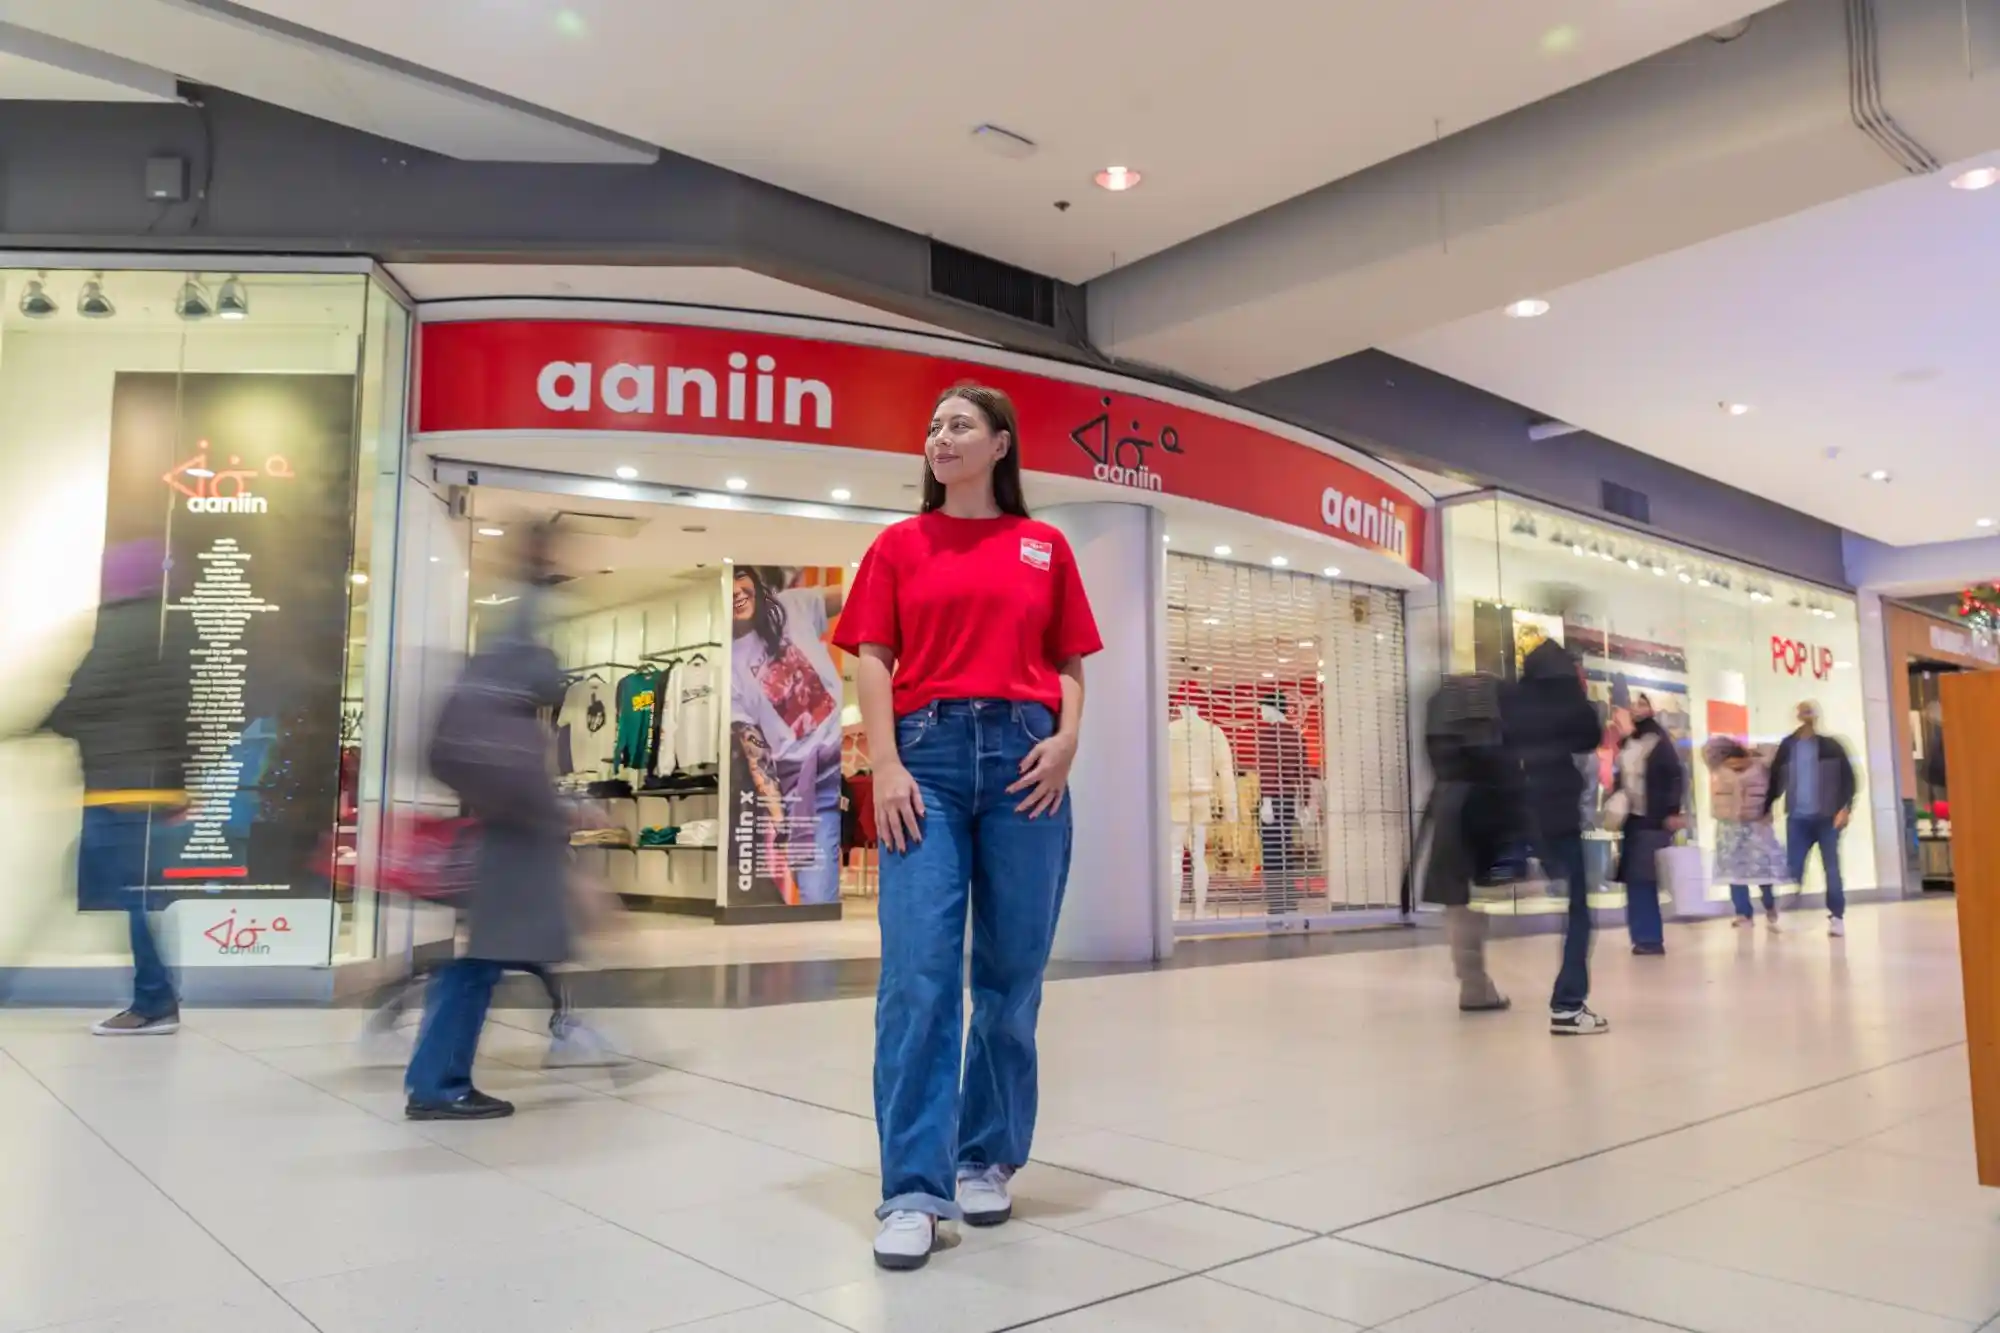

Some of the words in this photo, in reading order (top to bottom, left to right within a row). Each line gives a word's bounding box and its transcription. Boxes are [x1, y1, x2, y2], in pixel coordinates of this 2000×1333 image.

[537, 352, 832, 429] aaniin
[1093, 463, 1163, 491] aaniin
[186, 492, 268, 514] aaniin
[1321, 487, 1406, 558] aaniin
[1771, 636, 1807, 677] POP
[1811, 644, 1833, 681] UP
[740, 790, 754, 805] x
[735, 812, 754, 891] aaniin
[218, 942, 271, 956] aaniin
